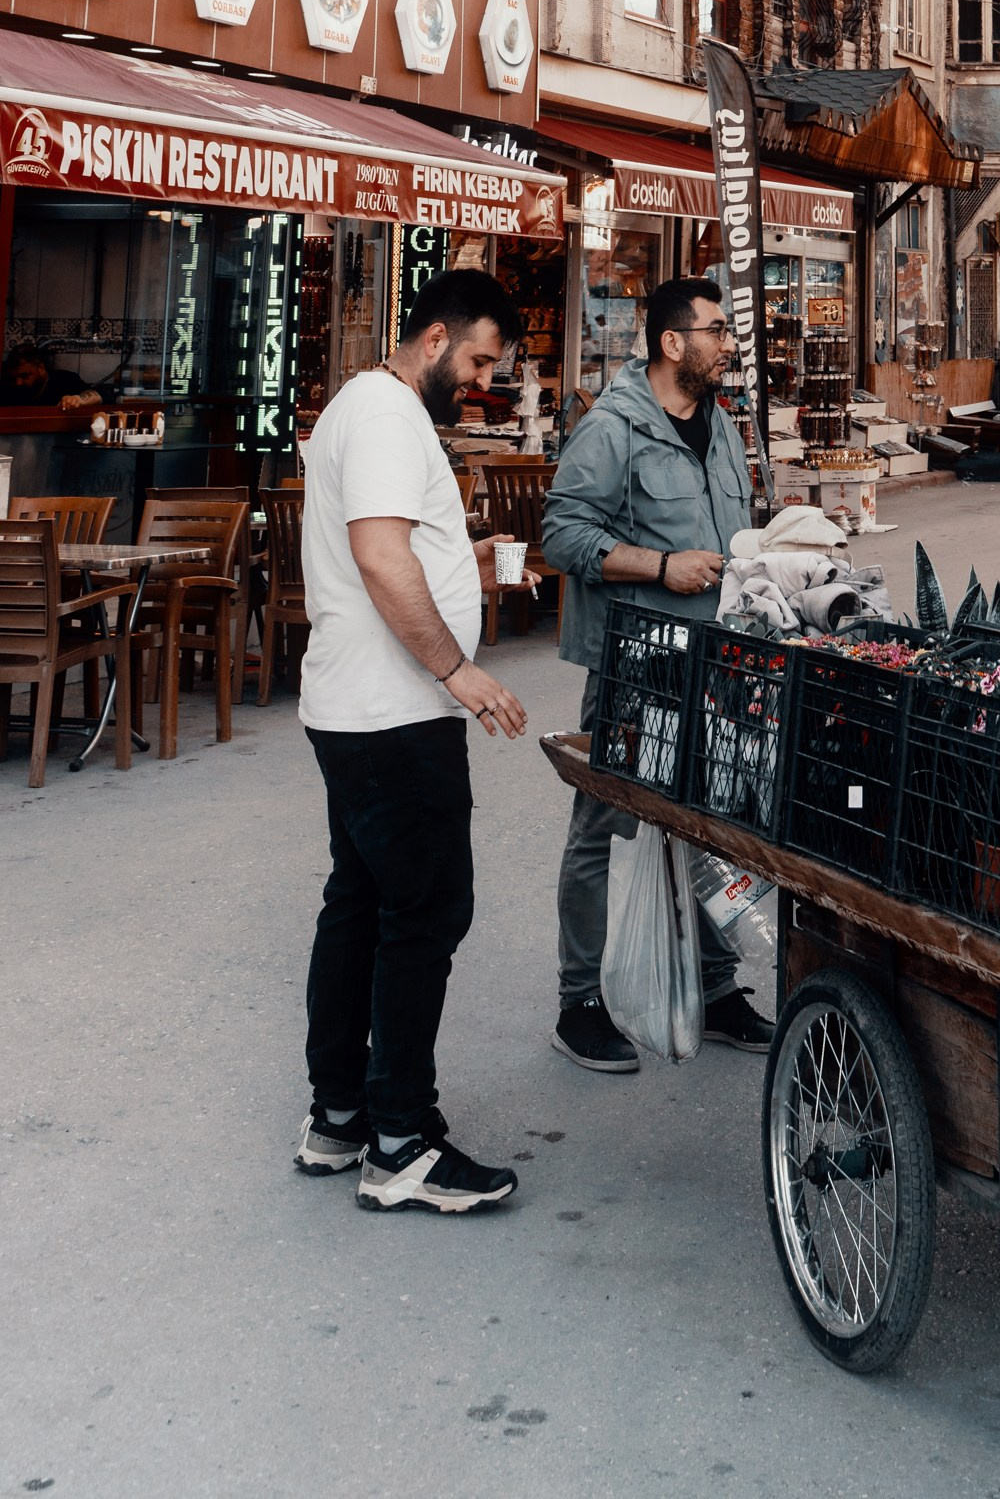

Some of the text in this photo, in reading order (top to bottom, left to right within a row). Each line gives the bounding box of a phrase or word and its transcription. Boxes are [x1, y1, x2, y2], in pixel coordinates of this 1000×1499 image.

[212, 0, 248, 18] ÇORBASI
[323, 28, 350, 46] IZGARA
[502, 75, 520, 87] ARASI
[168, 137, 339, 204] RESTAURANT
[356, 163, 523, 203] 1980'DEN FIRIN KEBAP
[630, 175, 675, 208] dostlar
[355, 190, 399, 213] BUGÜNE
[461, 202, 522, 233] EKMEK
[812, 200, 845, 226] dostlar
